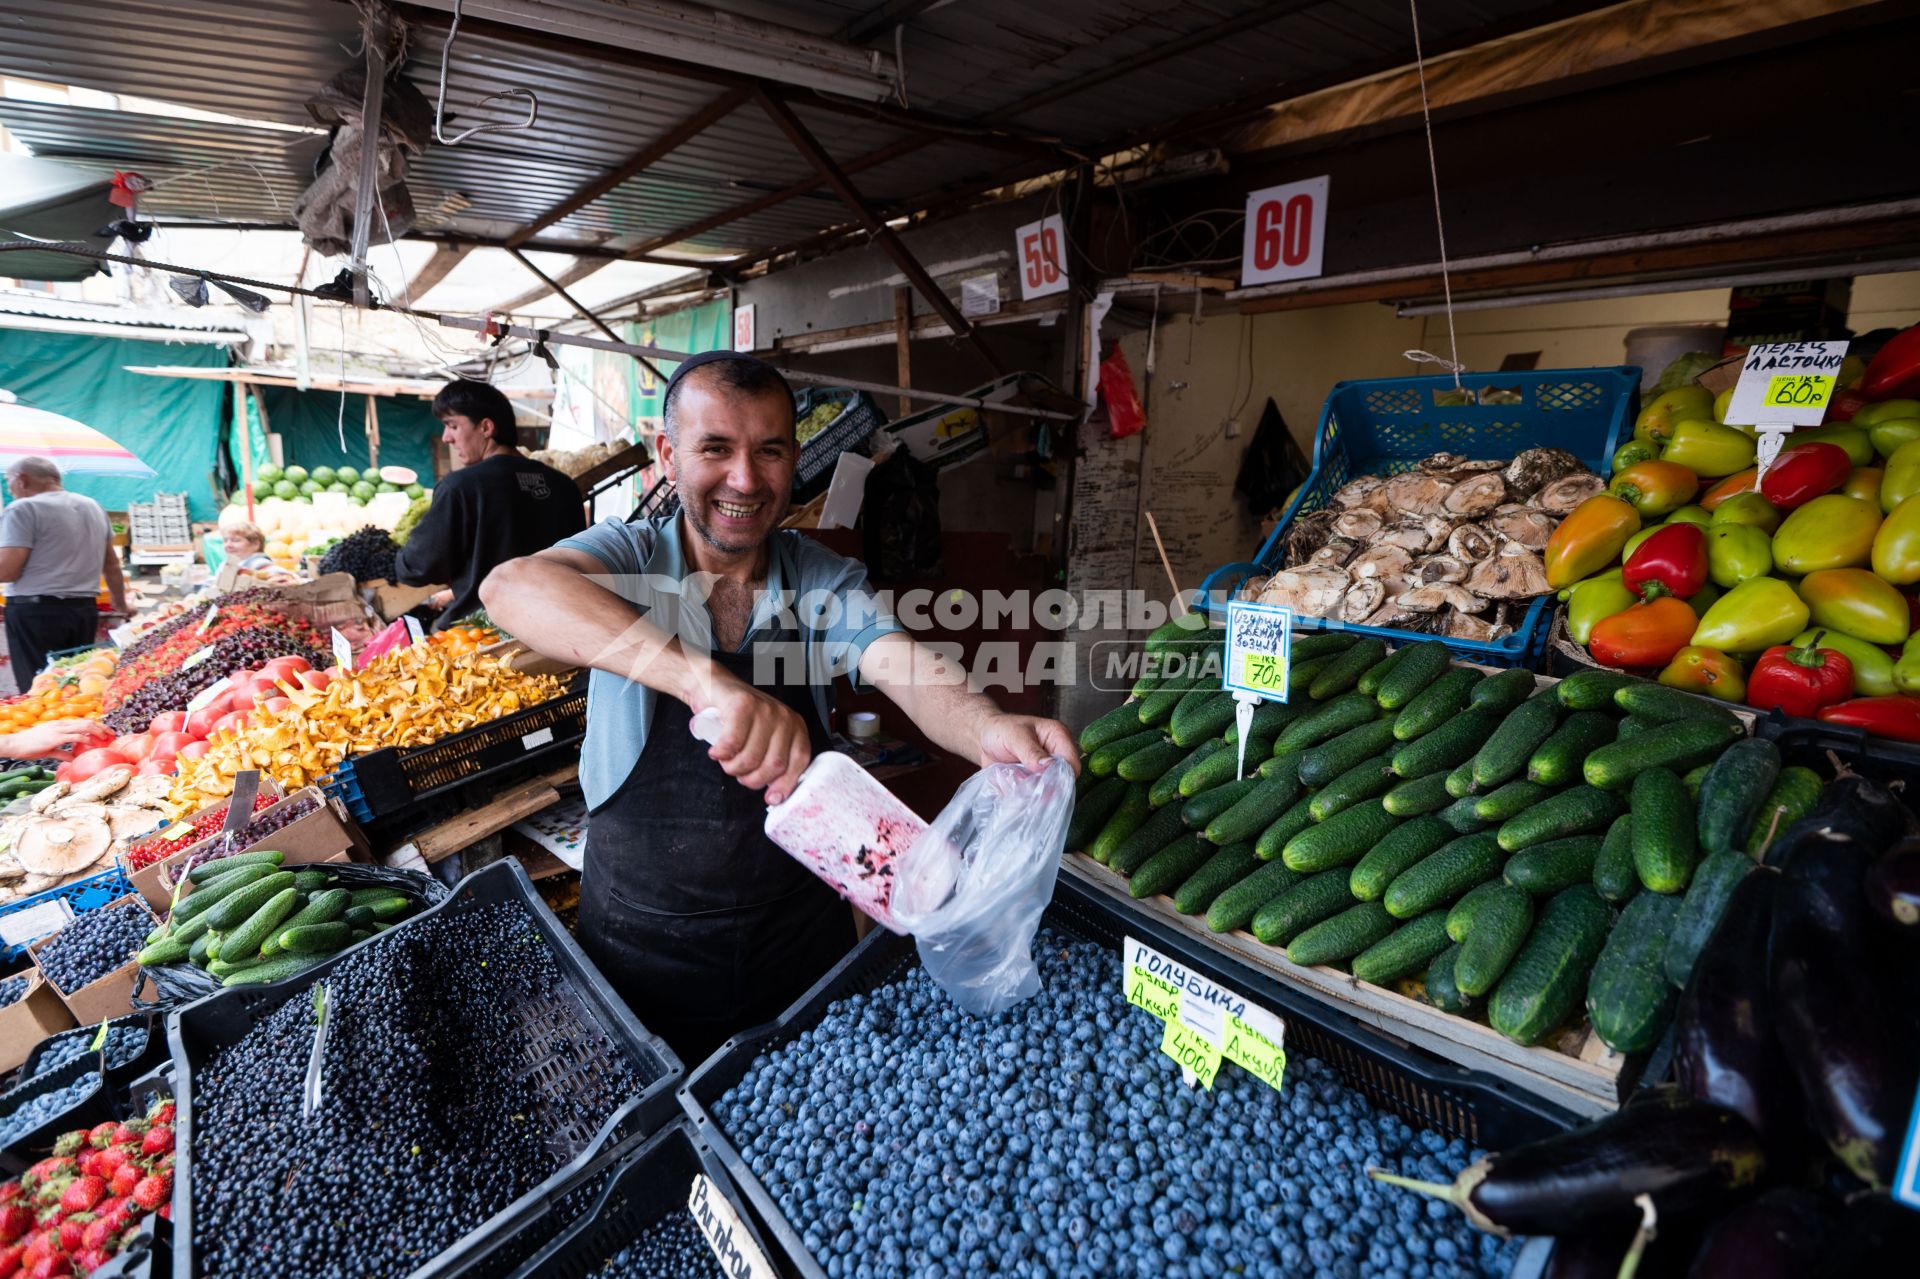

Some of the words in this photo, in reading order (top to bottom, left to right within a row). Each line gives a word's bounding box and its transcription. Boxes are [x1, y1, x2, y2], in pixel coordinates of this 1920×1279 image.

[1253, 193, 1313, 271] 60
[1023, 227, 1060, 289] 59
[737, 311, 752, 346] 58
[1775, 382, 1823, 405] 60р
[1252, 663, 1282, 689] 70р
[1135, 946, 1247, 1018] ГОЛУБИКА
[1172, 1032, 1211, 1080] 400р
